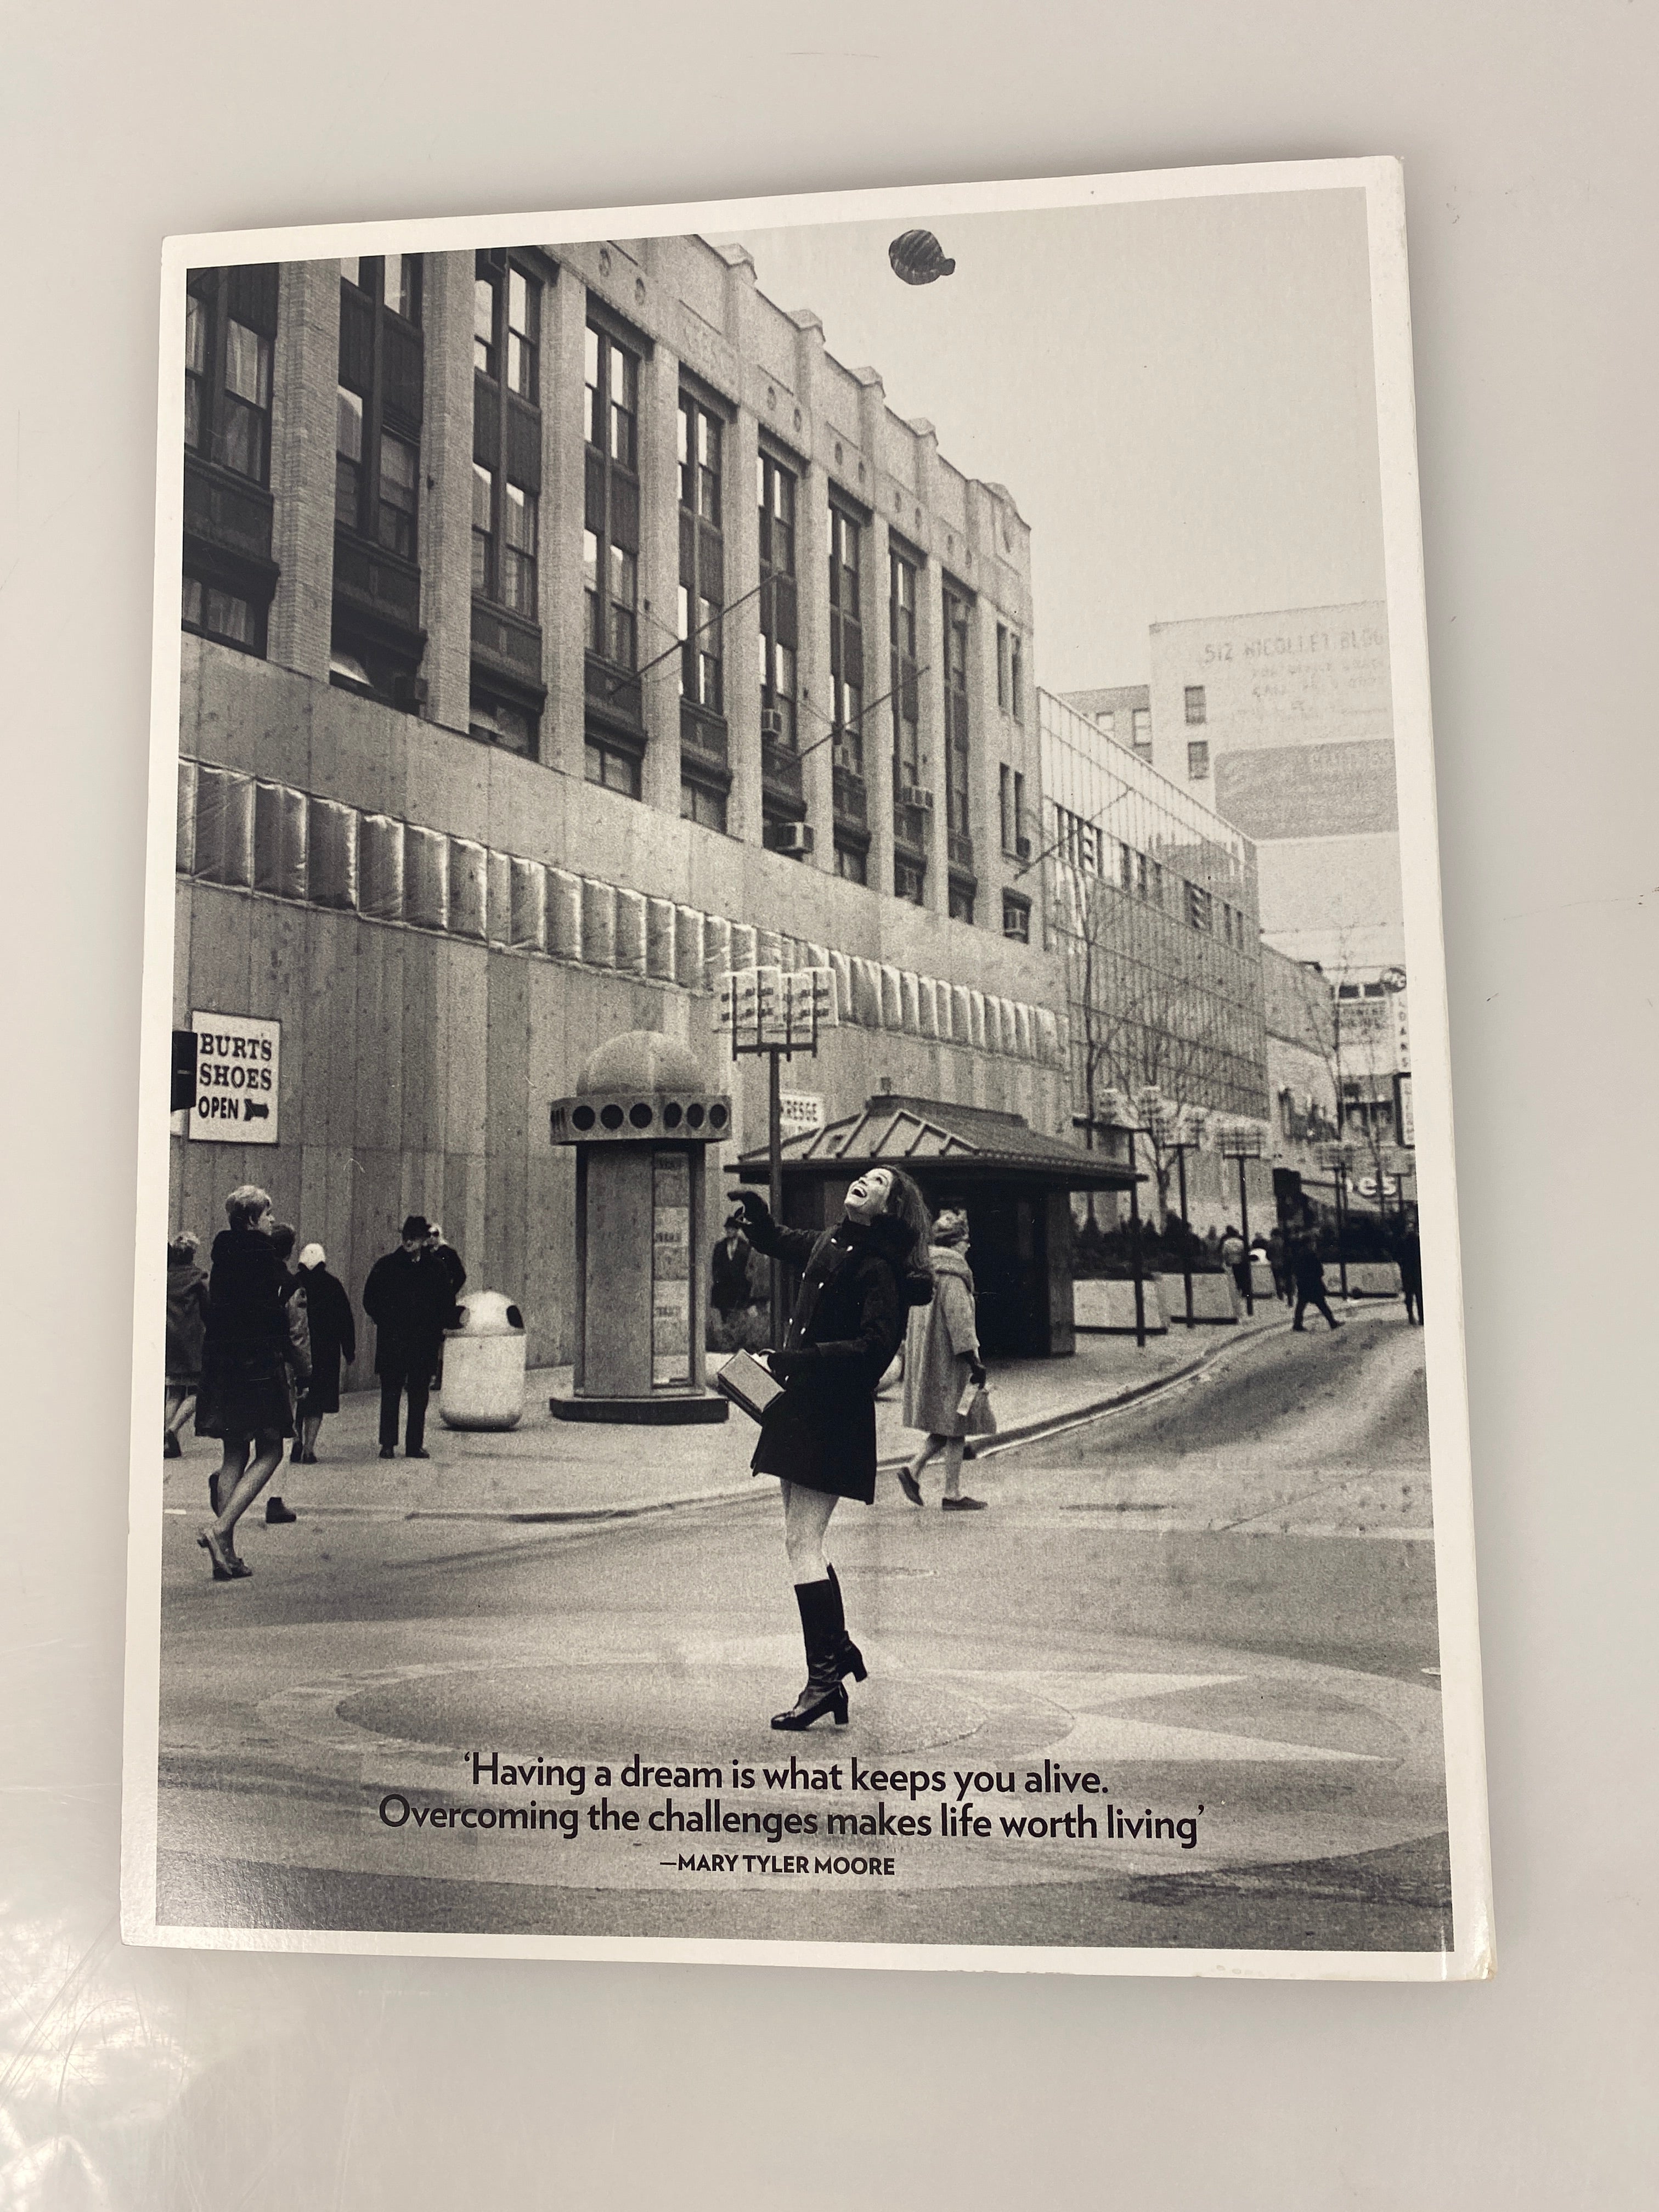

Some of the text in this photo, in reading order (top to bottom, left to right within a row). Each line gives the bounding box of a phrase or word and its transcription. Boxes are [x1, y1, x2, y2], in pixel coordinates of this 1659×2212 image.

[199, 1063, 272, 1091] SHOES
[198, 1096, 239, 1119] OPEN
[595, 1765, 612, 1786] a
[621, 1753, 723, 1788] dream
[732, 1759, 755, 1789] is
[763, 1757, 843, 1790] what
[851, 1757, 946, 1801] keeps
[953, 1770, 1015, 1801] you
[1025, 1759, 1109, 1793] alive.
[379, 1793, 579, 1839] Overcoming
[588, 1797, 640, 1830] the
[648, 1798, 819, 1842] challenges
[827, 1803, 932, 1836] makes
[941, 1803, 991, 1837] life
[999, 1804, 1098, 1838] worth
[742, 1855, 809, 1874] TYLER
[814, 1856, 895, 1876] MOORE
